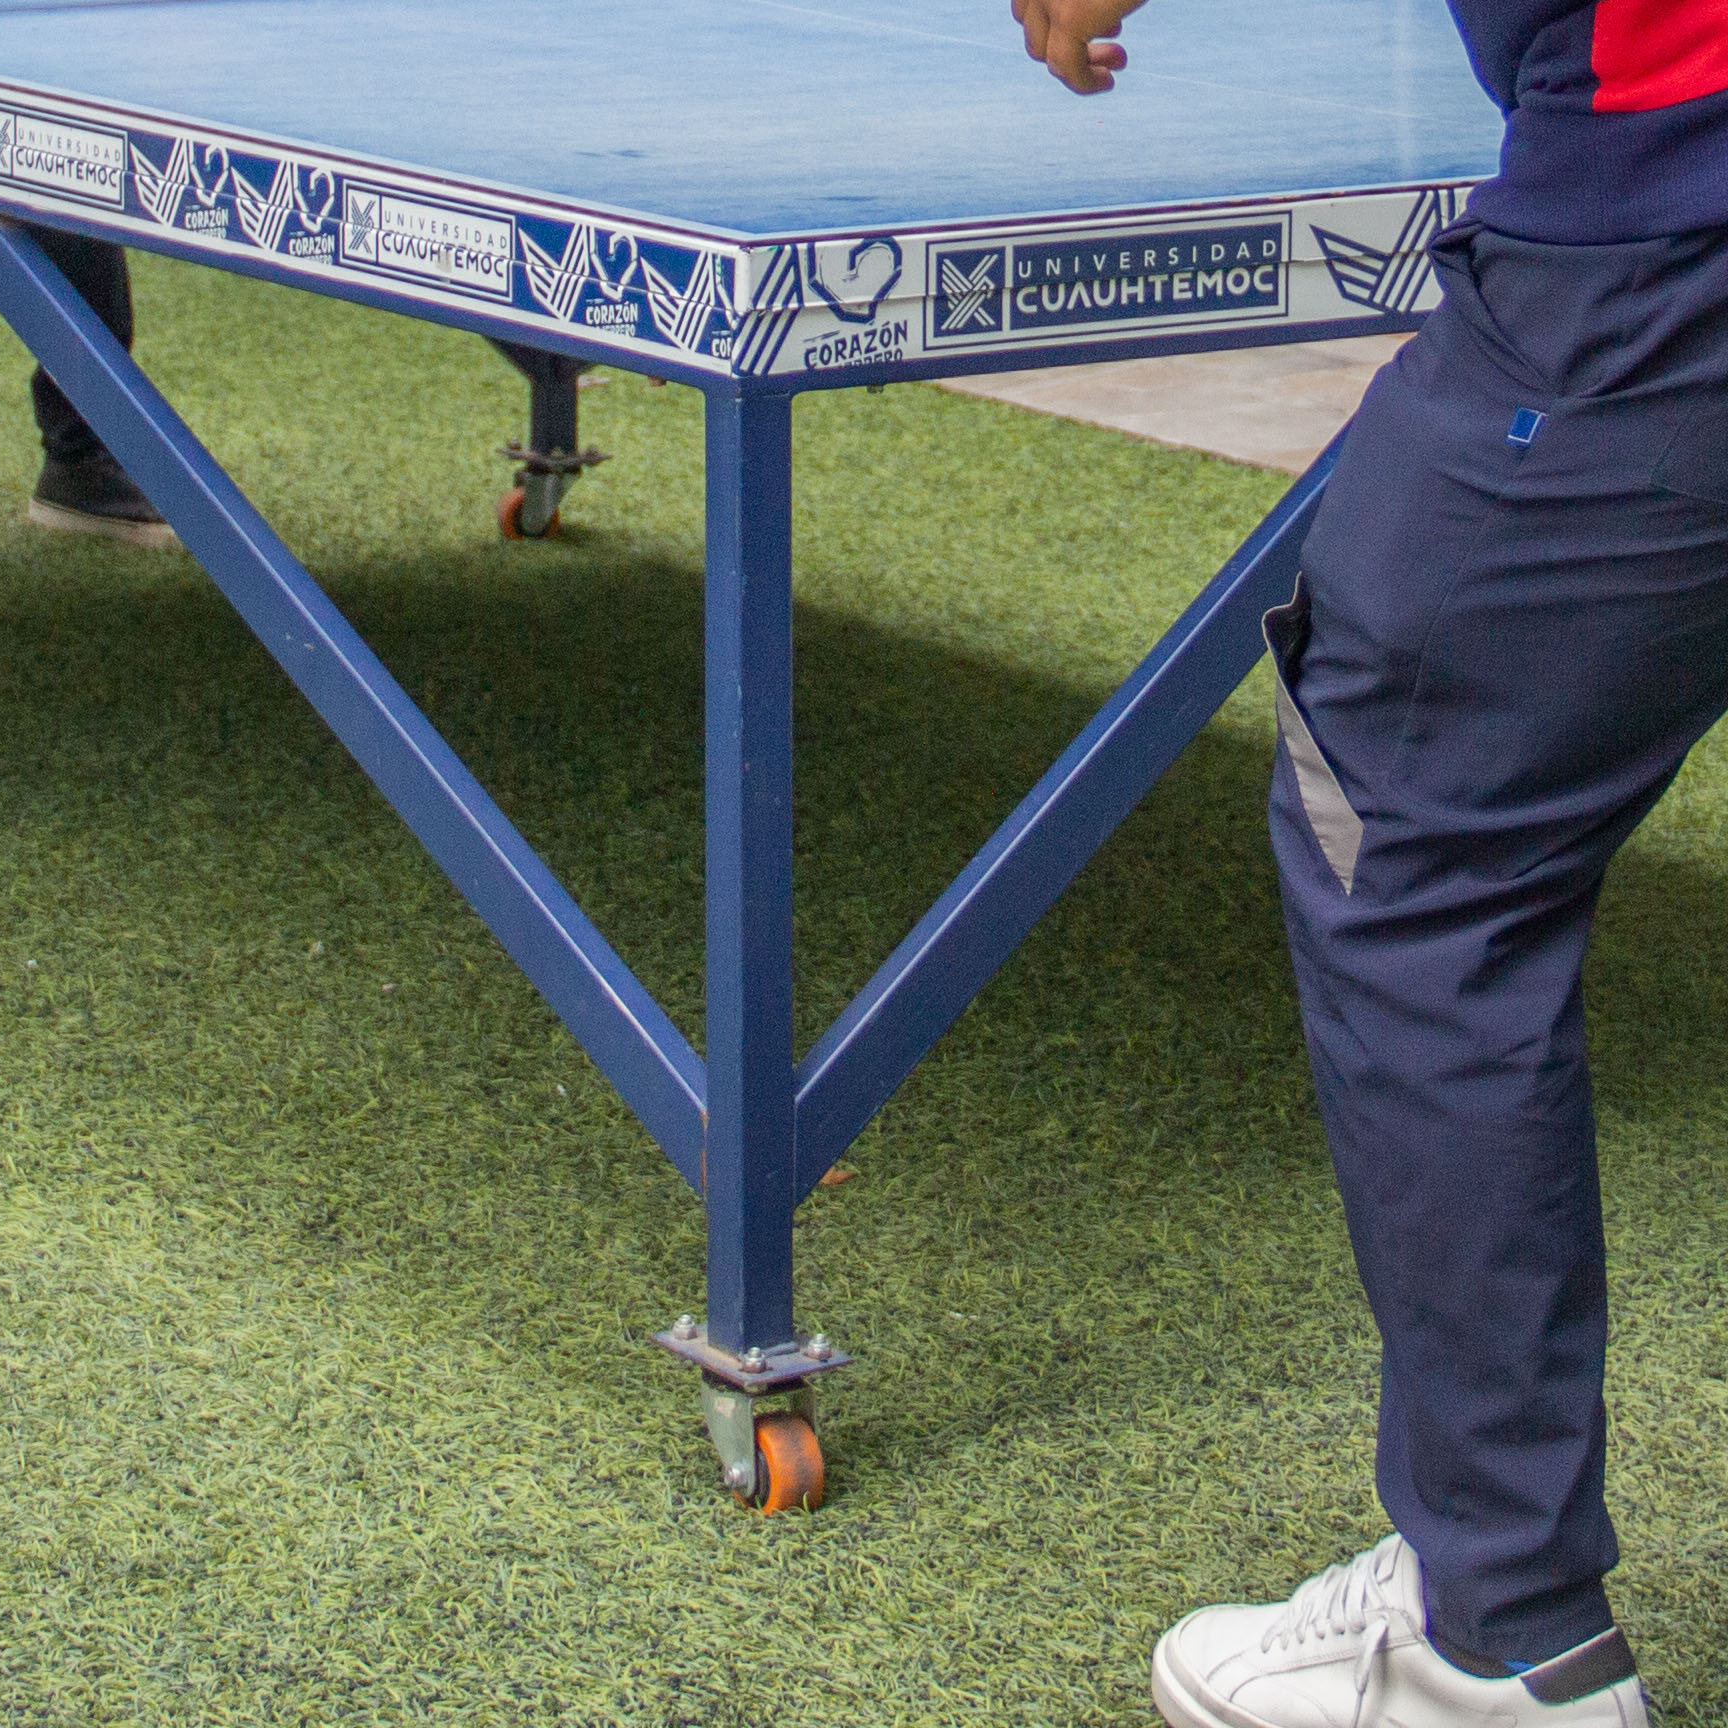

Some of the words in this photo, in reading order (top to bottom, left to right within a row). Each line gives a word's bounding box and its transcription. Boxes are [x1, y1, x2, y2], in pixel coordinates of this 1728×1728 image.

[18, 127, 122, 163] UNIVERSIDAD
[15, 147, 118, 189] CUAUHTEMOC
[184, 206, 229, 229] CORAZÓN
[384, 210, 508, 250] UNIVERSIDAD
[289, 232, 335, 256] CORAZÓN
[382, 230, 506, 278] CUAUHTEMOC
[1017, 239, 1277, 279] UNIVERSIDAD
[1015, 263, 1274, 314] CUAUHTEMOC
[585, 301, 639, 325] CORAZÓN
[803, 319, 909, 370] CORAZÓN
